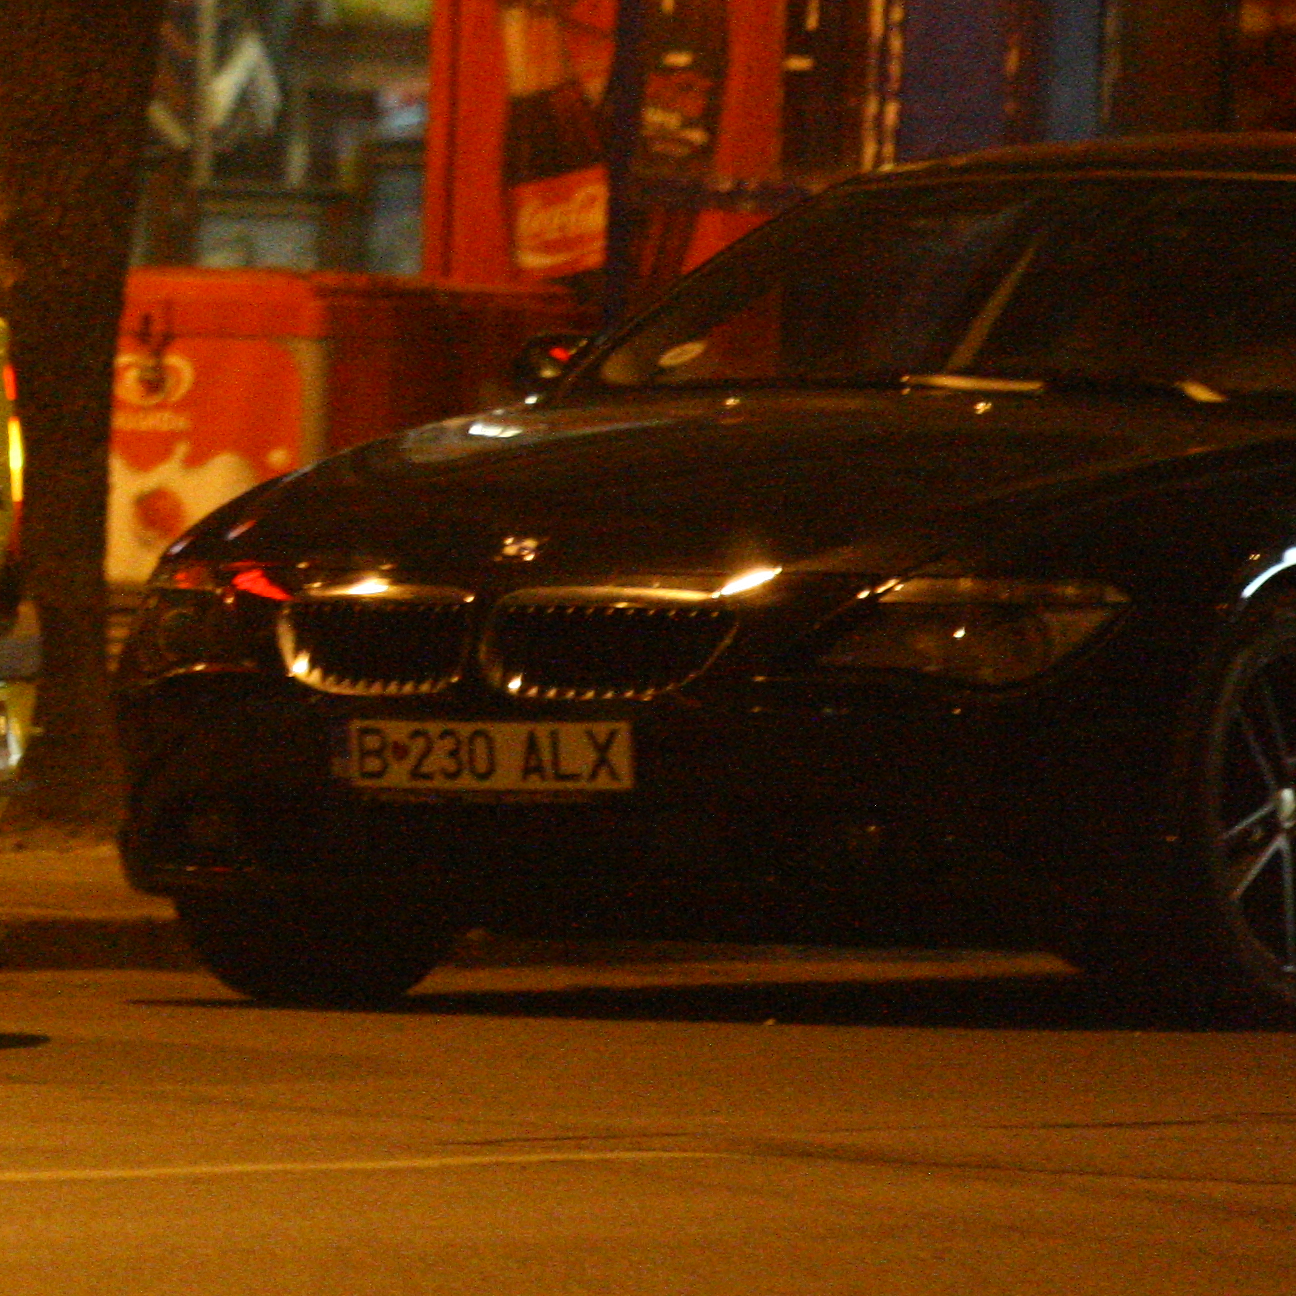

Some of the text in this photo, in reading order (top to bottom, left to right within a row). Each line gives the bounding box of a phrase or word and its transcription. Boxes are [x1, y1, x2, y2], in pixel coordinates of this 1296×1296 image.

[358, 727, 624, 783] B 230 ALX
